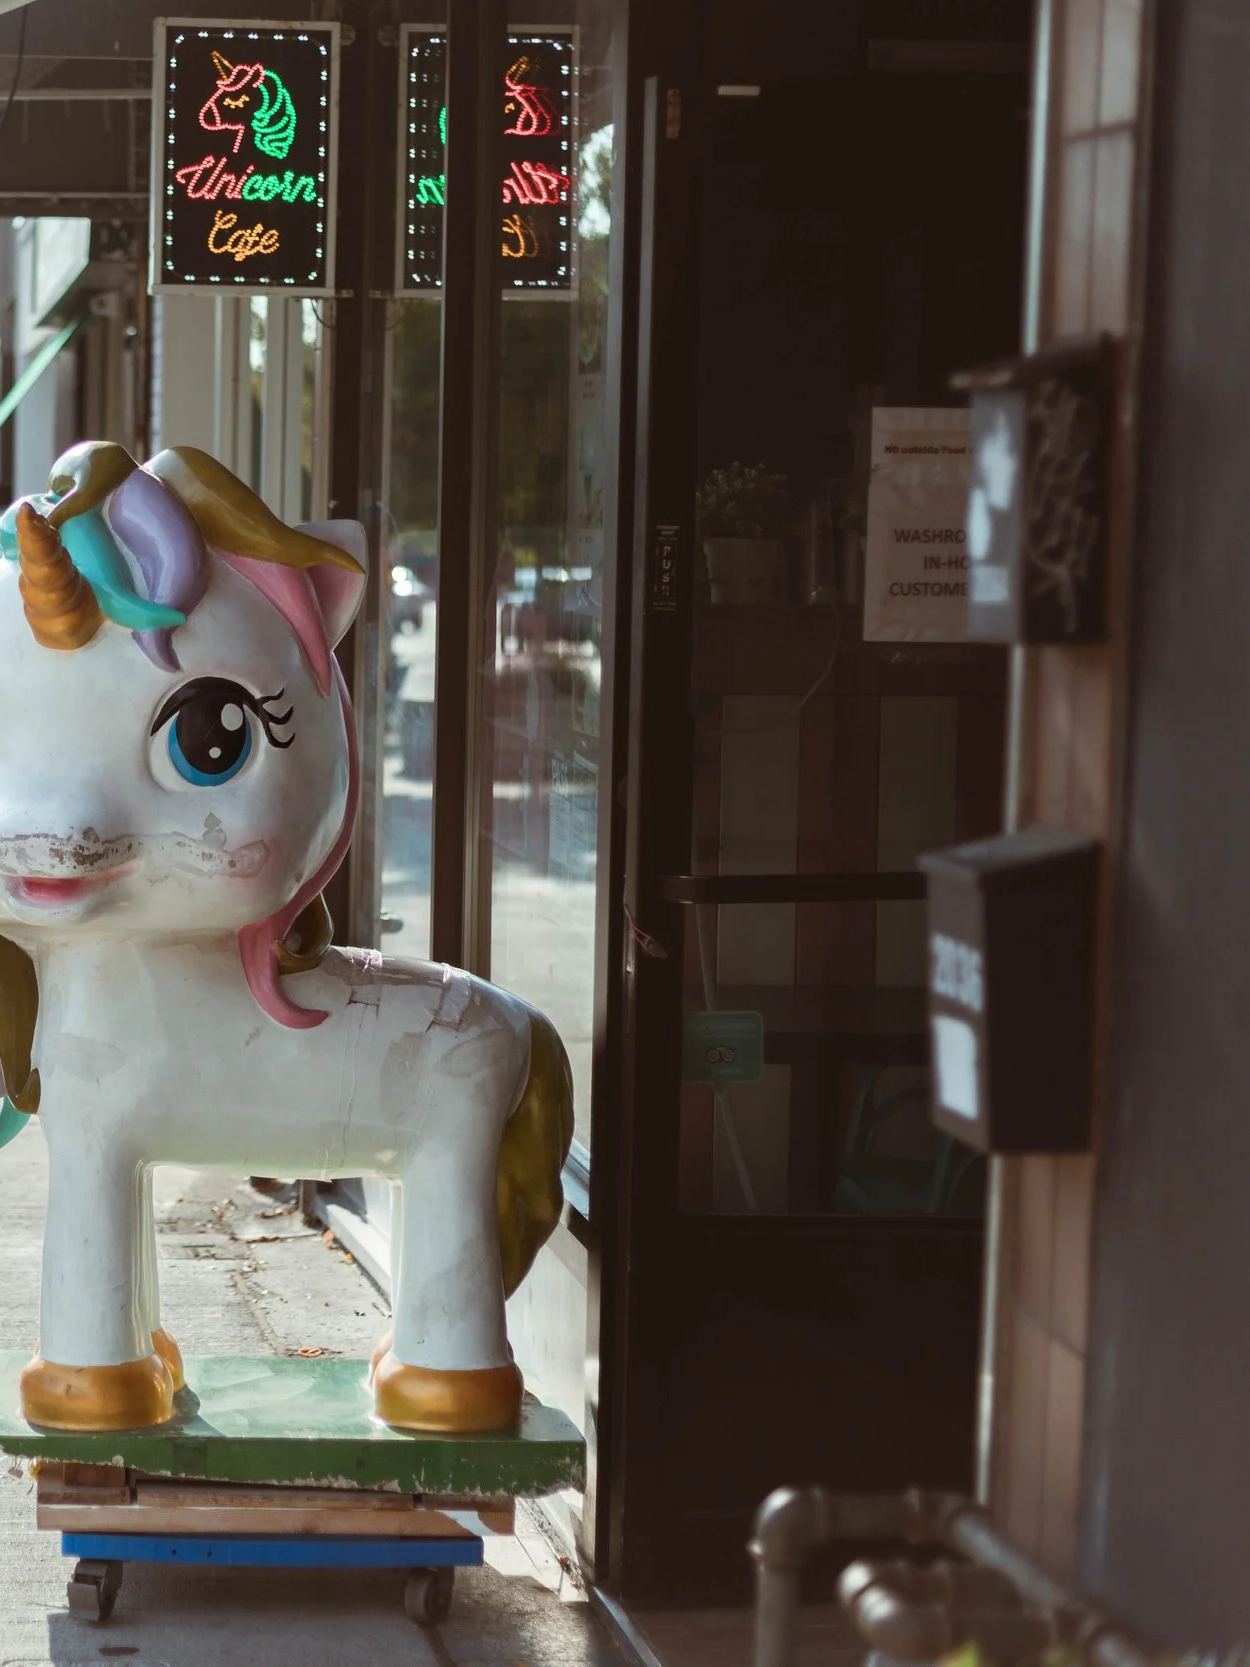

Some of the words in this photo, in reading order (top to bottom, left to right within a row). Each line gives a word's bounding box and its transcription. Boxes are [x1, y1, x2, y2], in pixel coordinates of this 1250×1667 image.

[176, 155, 317, 203] Unicorn
[208, 209, 280, 261] Cafe
[894, 528, 967, 544] WASHRO
[923, 556, 972, 571] IN-HO
[889, 581, 970, 597] CUSTOME
